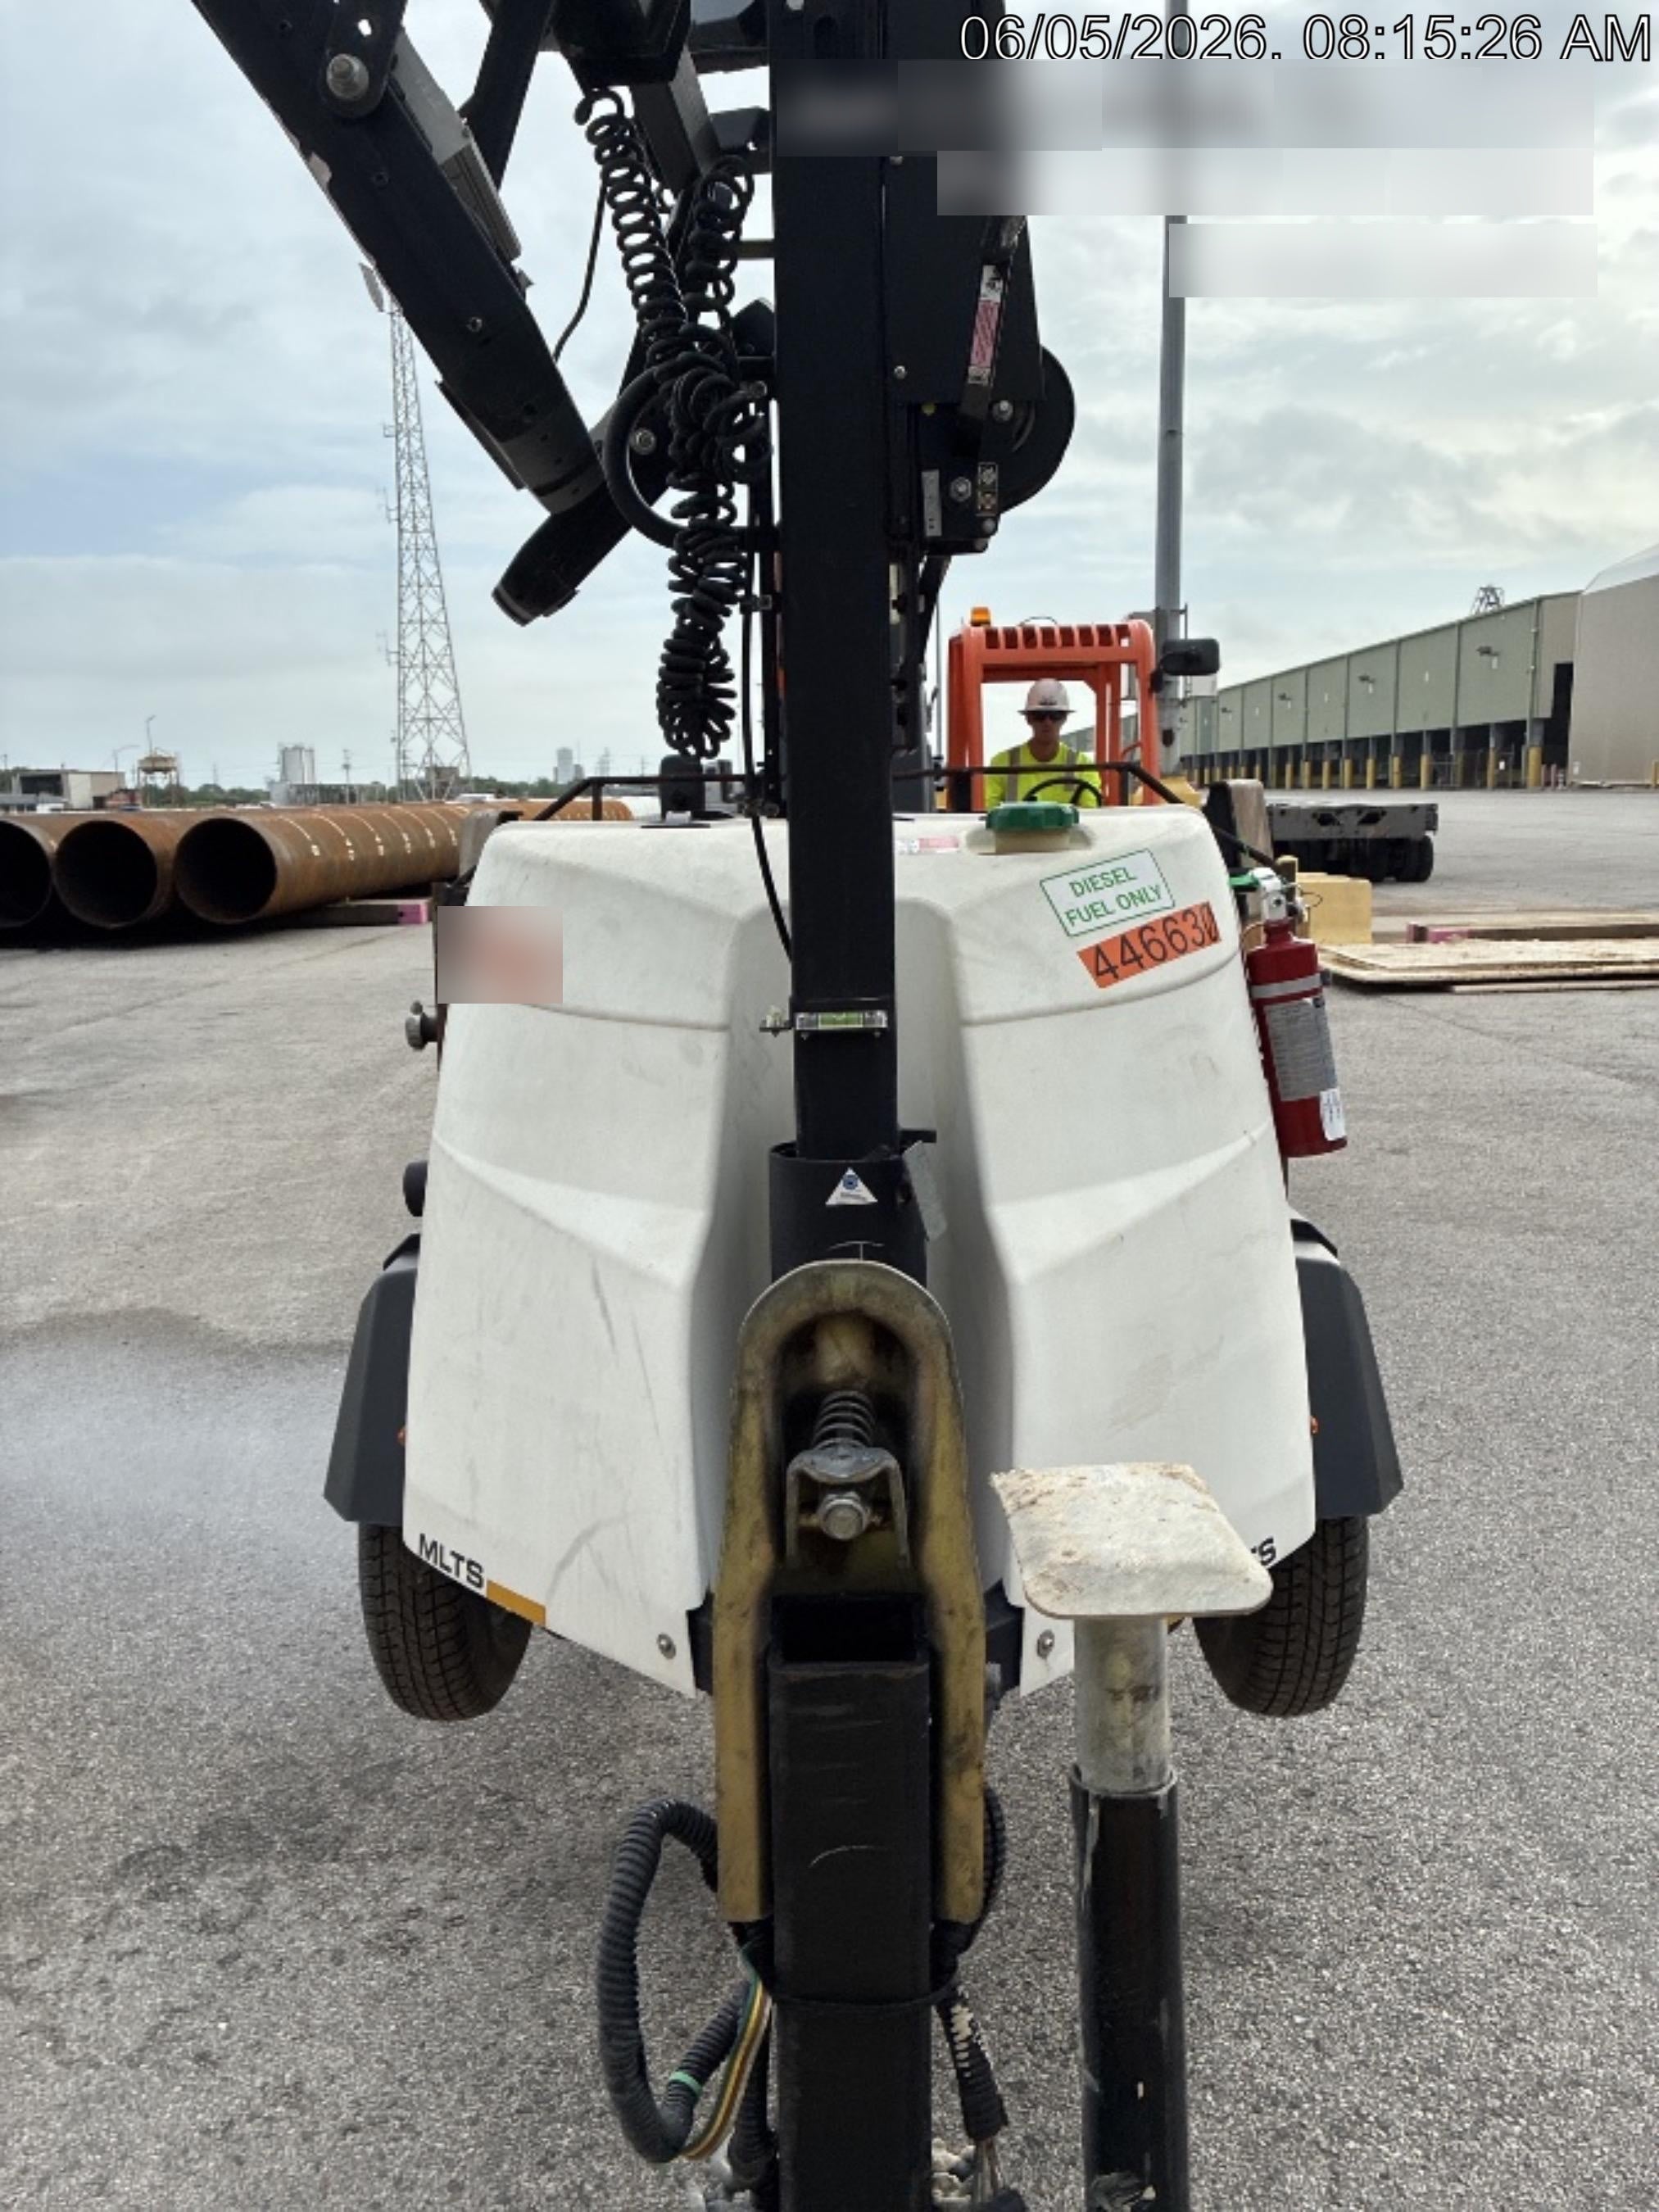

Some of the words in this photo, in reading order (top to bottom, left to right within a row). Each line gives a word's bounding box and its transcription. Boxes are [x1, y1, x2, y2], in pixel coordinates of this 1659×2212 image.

[1069, 866, 1137, 898] DIESEL
[1065, 900, 1116, 927] FUEL
[1115, 884, 1162, 910] ONLY
[419, 1533, 484, 1589] MLTS
